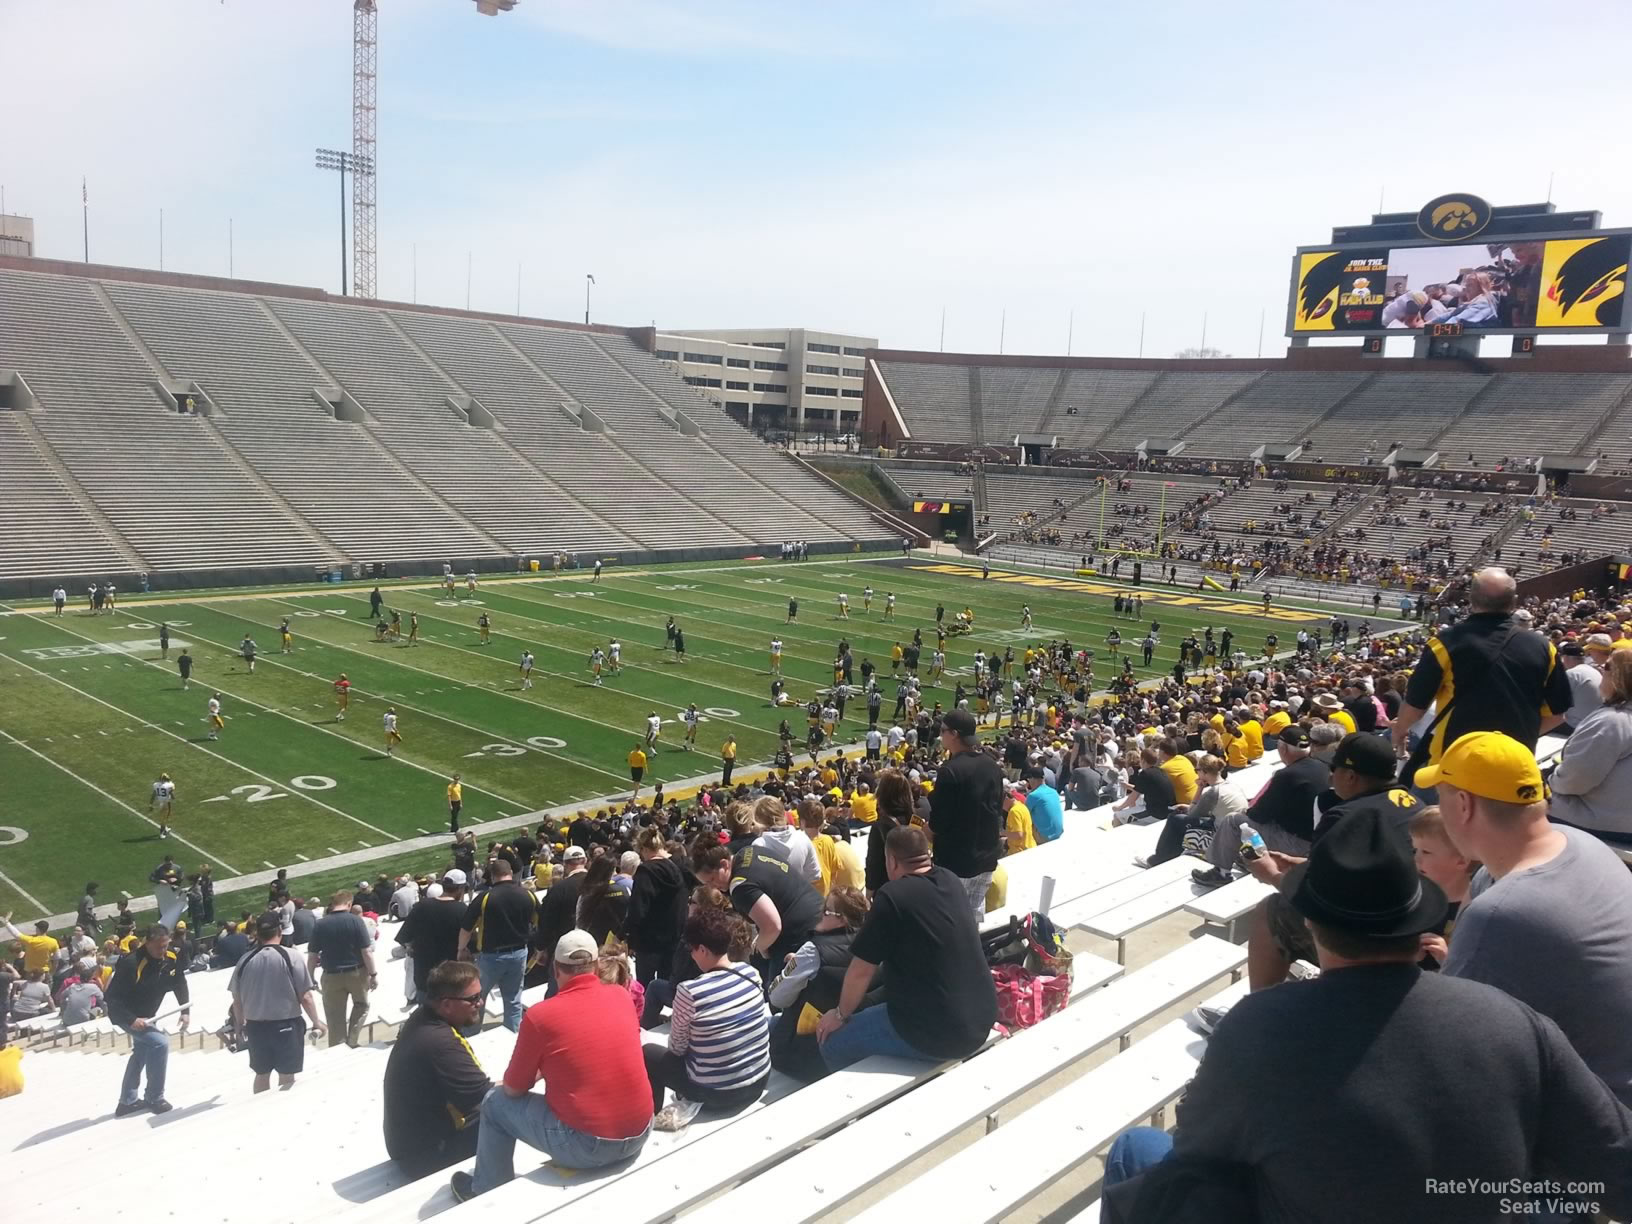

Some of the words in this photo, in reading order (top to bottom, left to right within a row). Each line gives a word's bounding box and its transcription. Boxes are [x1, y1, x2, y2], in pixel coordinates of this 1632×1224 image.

[1348, 259, 1367, 267] JOIN
[1368, 258, 1384, 266] THE
[1363, 294, 1384, 305] CLUB
[1372, 340, 1380, 352] 0
[1522, 339, 1531, 351] 0
[481, 736, 568, 757] 30
[156, 788, 167, 797] 13
[230, 775, 338, 804] 20
